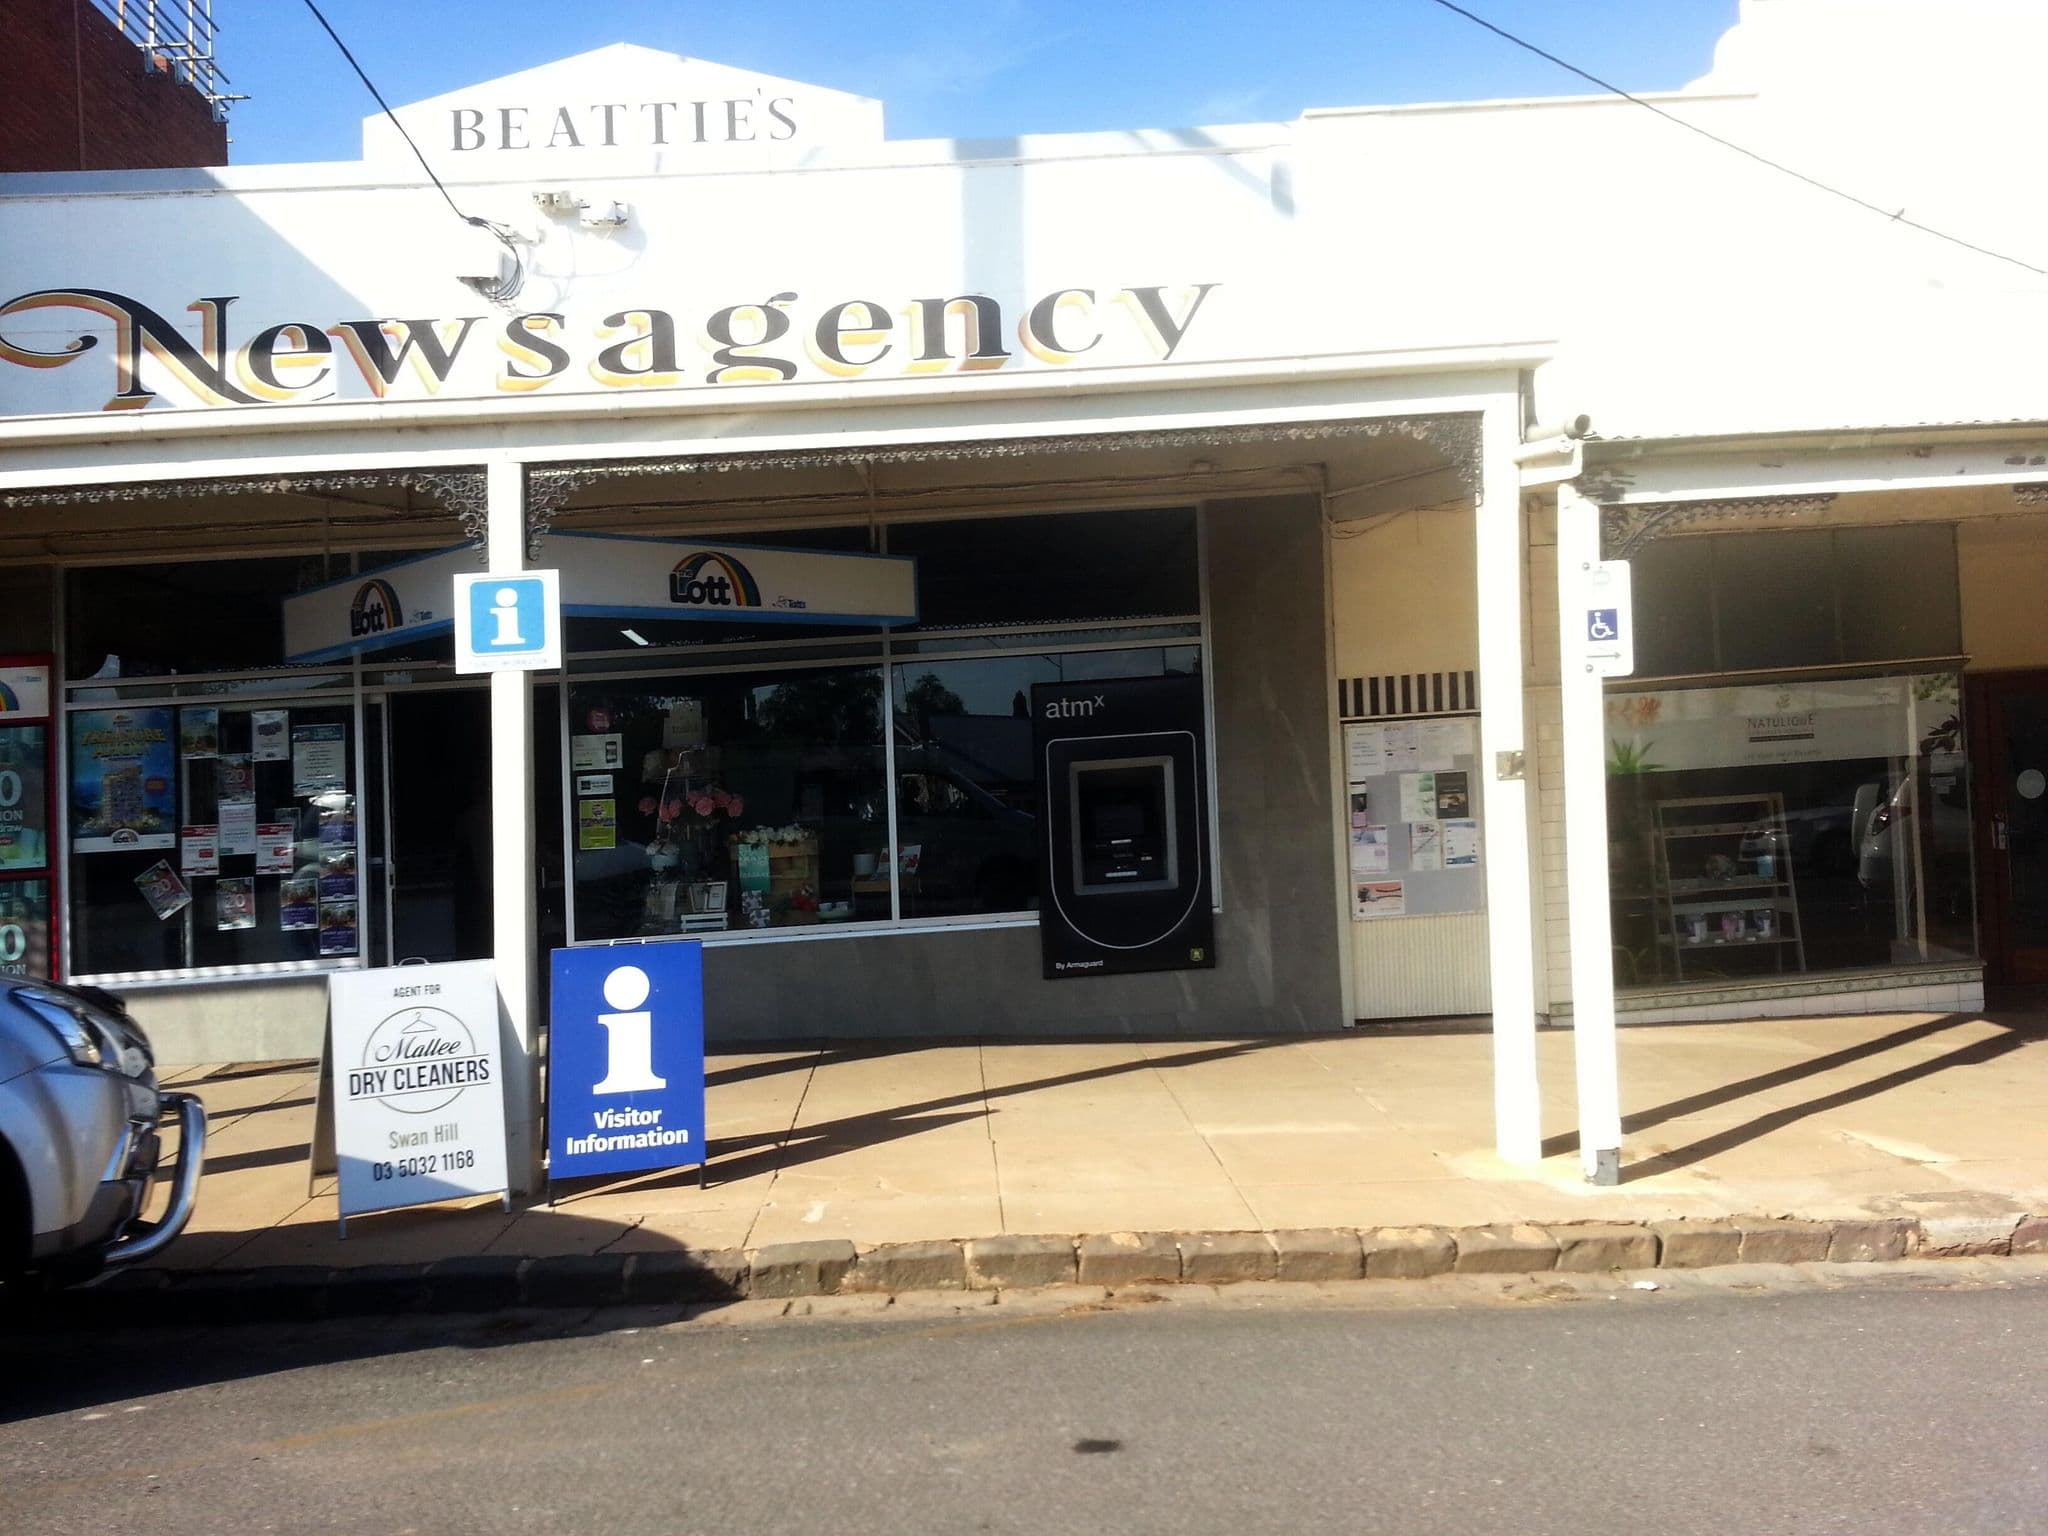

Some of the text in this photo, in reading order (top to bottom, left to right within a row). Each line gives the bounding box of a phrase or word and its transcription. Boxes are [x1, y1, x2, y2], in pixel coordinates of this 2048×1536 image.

[450, 88, 797, 151] BEATTIE'S
[0, 283, 1223, 406] Newsagency
[669, 572, 731, 605] Lott
[351, 602, 385, 637] Lott
[394, 983, 442, 998] AGENT FOR
[375, 1036, 462, 1062] Mallee
[350, 1058, 490, 1096] DRY CLEANERS
[594, 1107, 663, 1129] Visitor
[389, 1122, 459, 1150] Swan Hill
[567, 1127, 689, 1155] Information
[373, 1149, 475, 1181] 03 5032 1168
